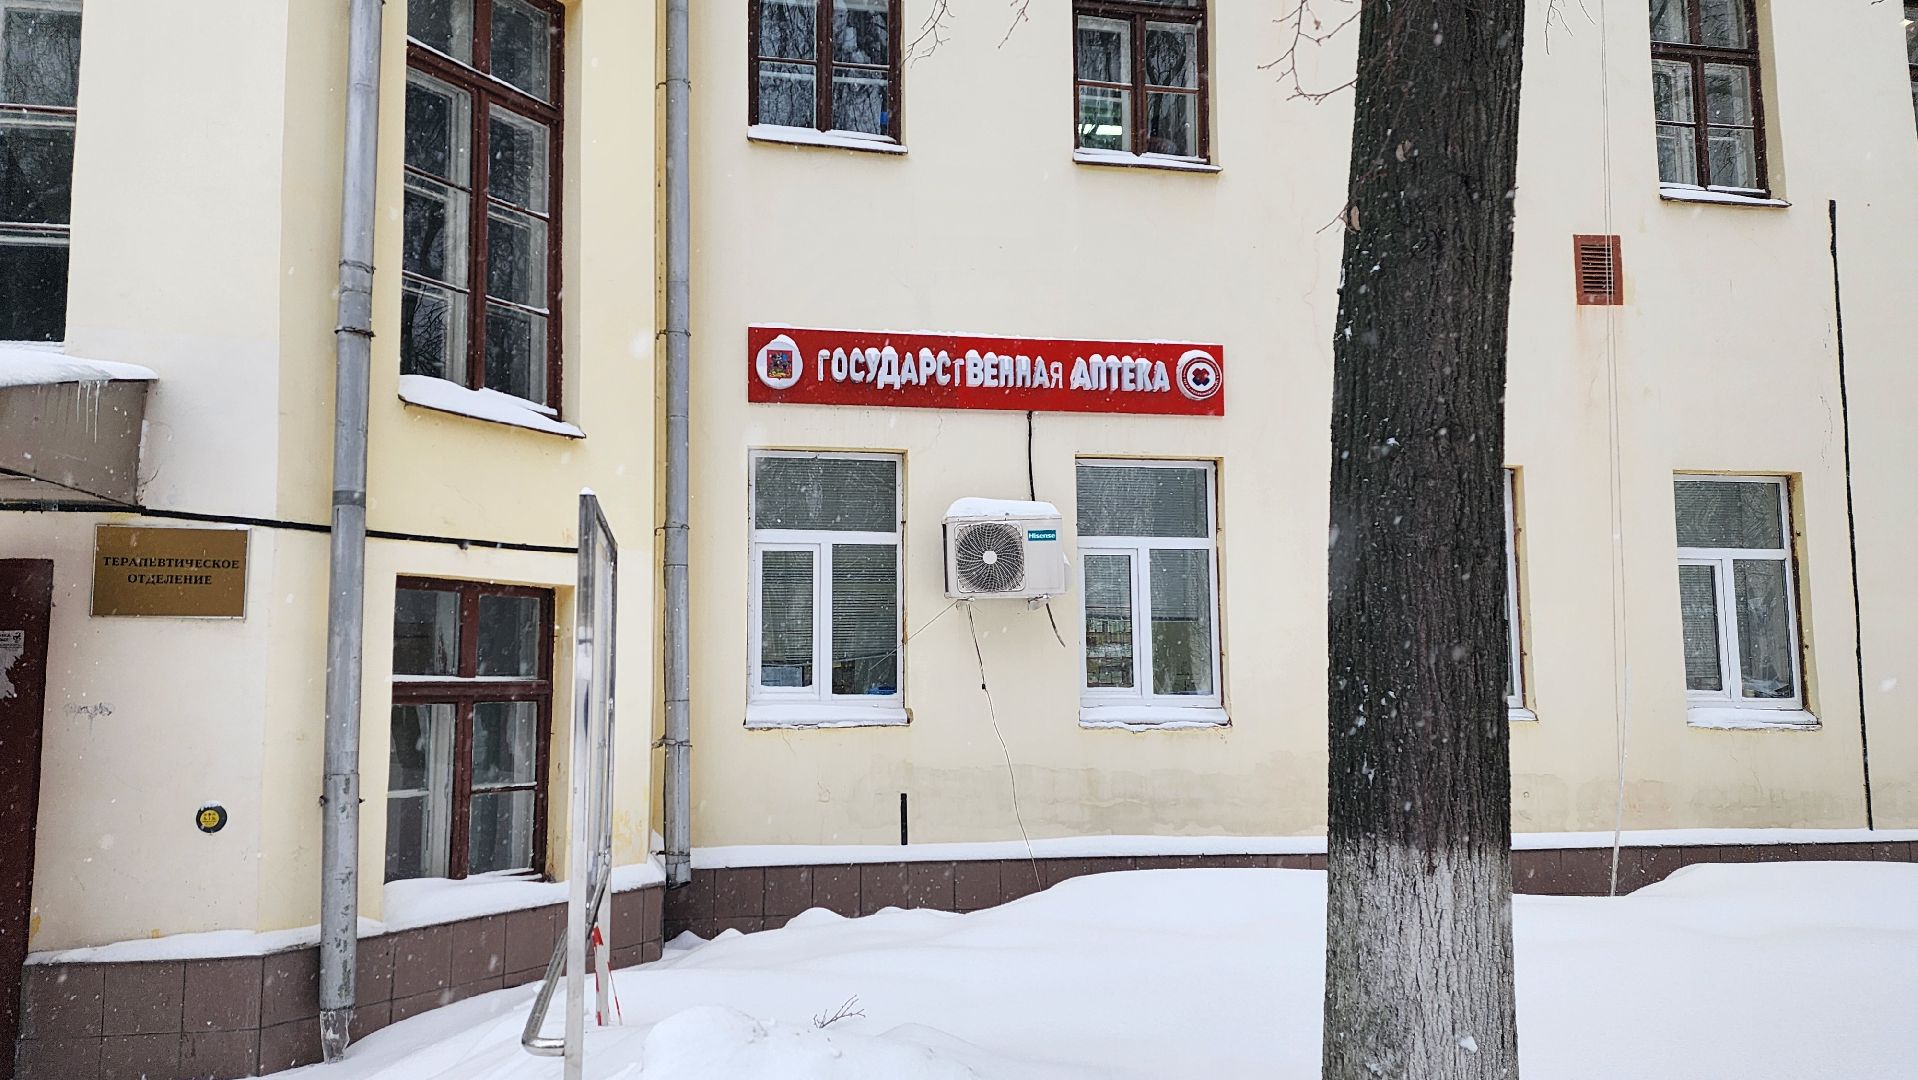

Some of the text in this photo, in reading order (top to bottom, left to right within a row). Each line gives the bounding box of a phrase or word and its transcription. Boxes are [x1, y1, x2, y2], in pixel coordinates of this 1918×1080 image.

[817, 347, 1063, 389] ГОСУДАРСТВЕННАЯ
[1070, 354, 1171, 392] АПТЕКА
[103, 556, 240, 569] ТЕРАПЕВТИЧЕСКОЕ
[127, 573, 212, 585] ОТДЕЛЕНИЕ
